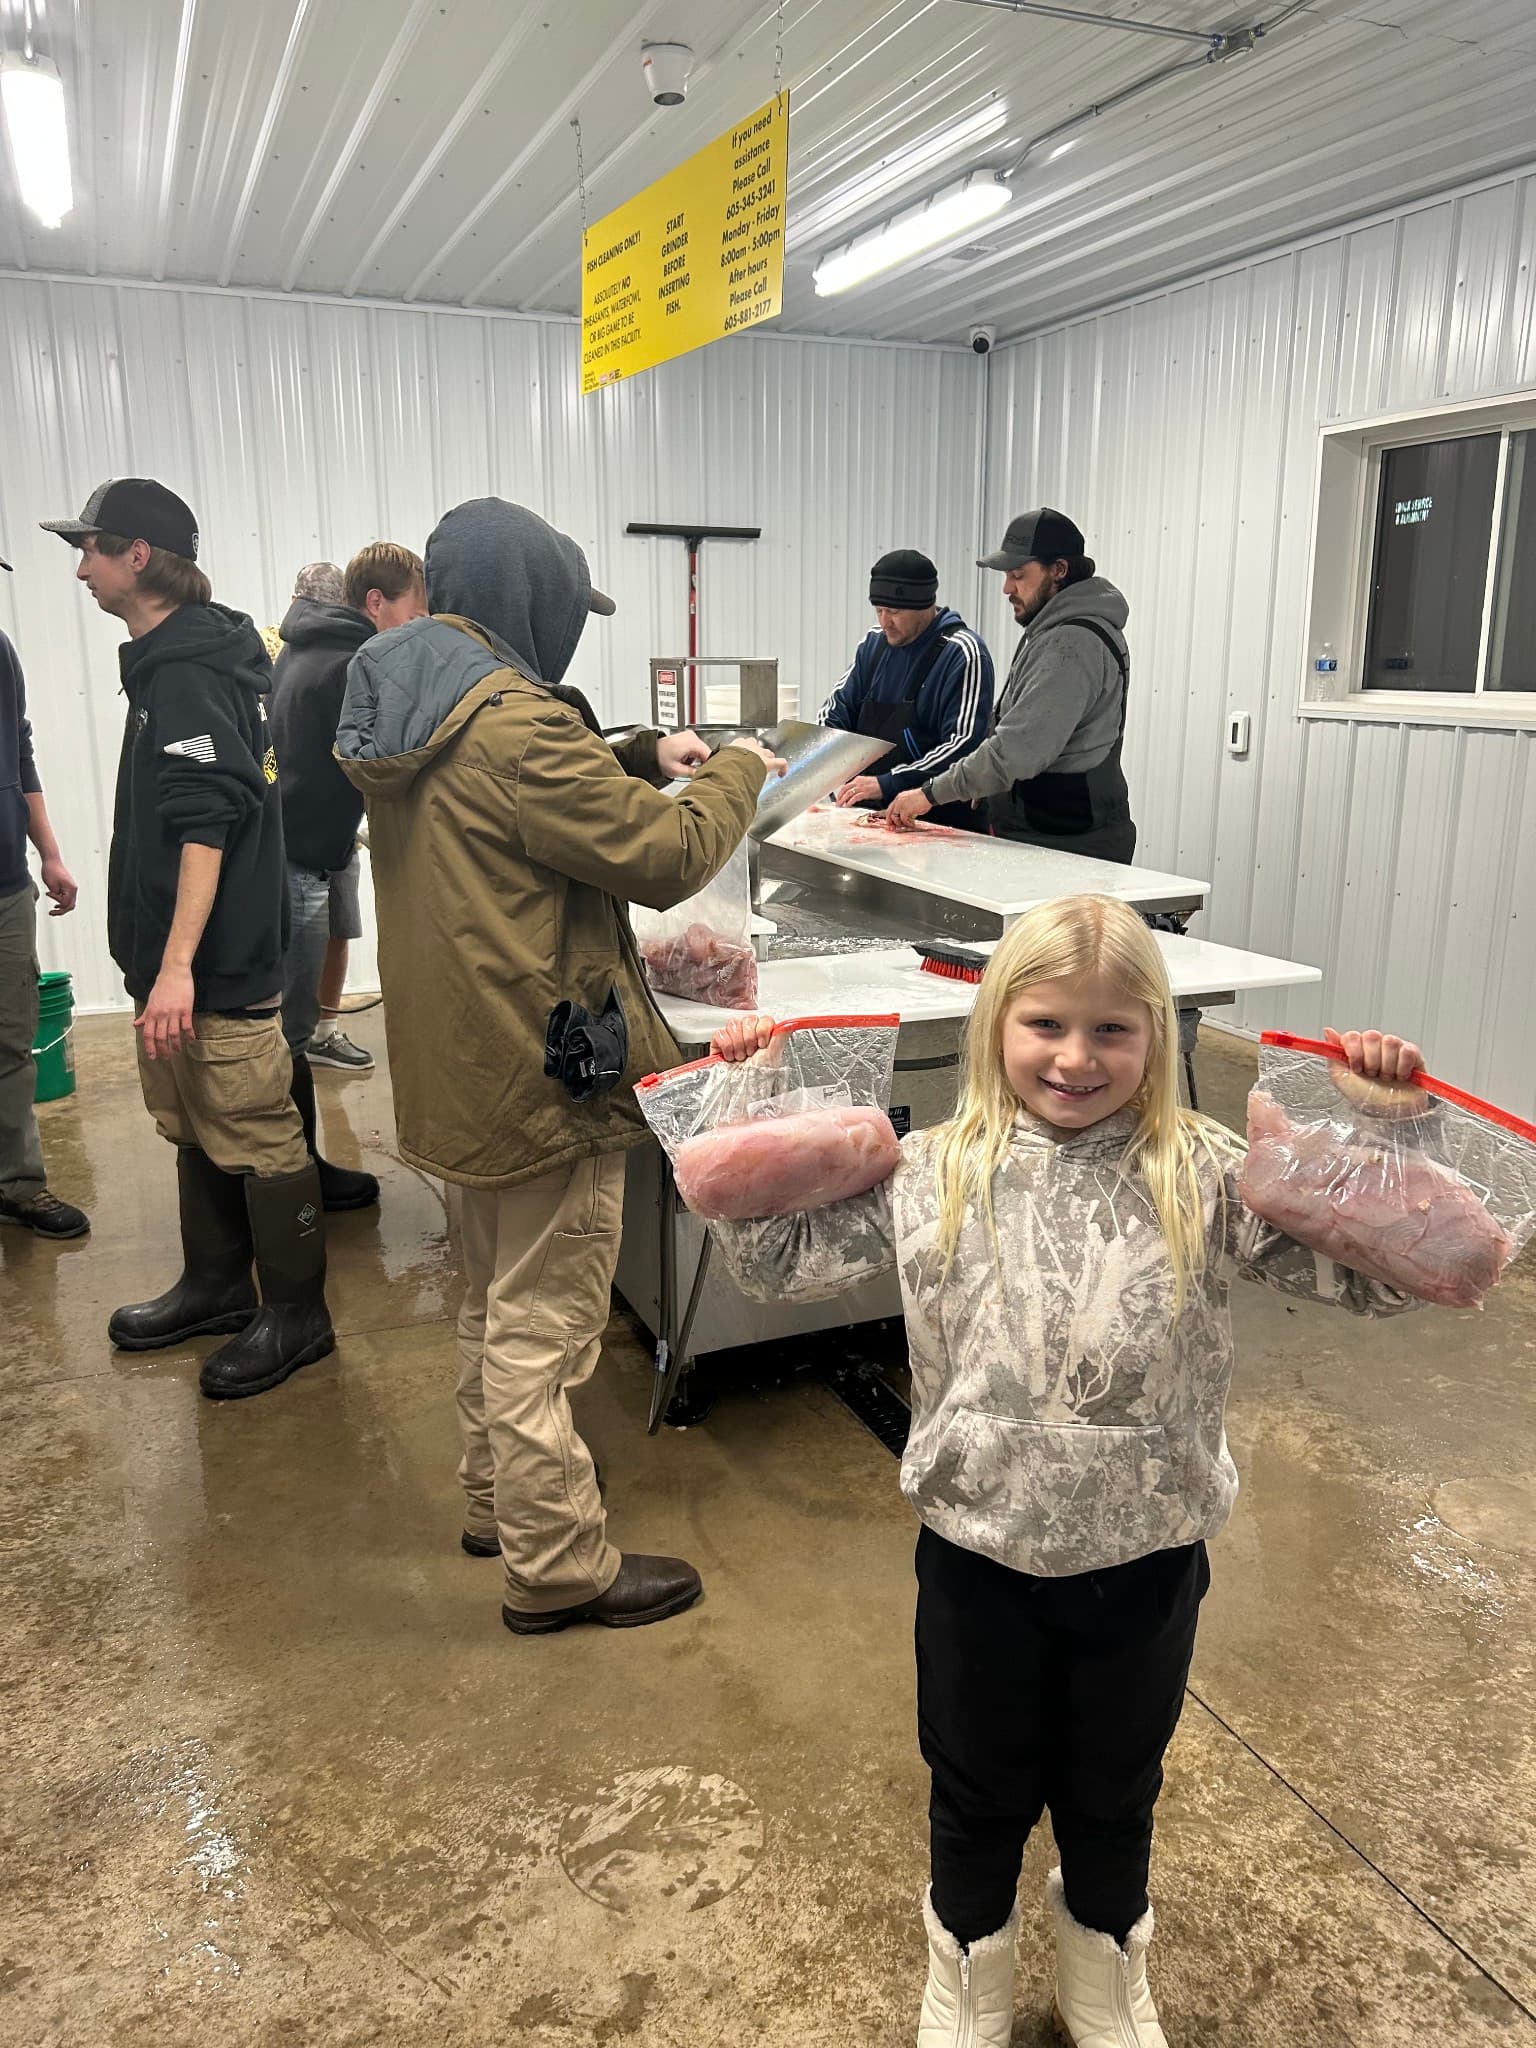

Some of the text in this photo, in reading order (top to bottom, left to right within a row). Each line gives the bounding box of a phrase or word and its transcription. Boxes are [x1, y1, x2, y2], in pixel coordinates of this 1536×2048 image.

[732, 108, 772, 149] If you need
[734, 138, 770, 170] assistance
[733, 157, 771, 194] Please Call
[726, 179, 776, 220] 605-345-3241
[666, 212, 684, 234] START
[722, 220, 750, 246] Monday
[756, 204, 780, 228] Friday
[586, 230, 641, 274] FISH CLEANING ONLY!
[662, 232, 688, 258] GRINDER
[720, 243, 746, 268] 8:00am
[752, 228, 780, 252] 5:00pm
[664, 254, 686, 277] BEFORE
[728, 257, 767, 286] After hours
[594, 276, 631, 305] ABSOLUTELY NO
[658, 272, 690, 300] INSERTING
[730, 275, 767, 308] Please Call
[666, 299, 681, 316] FISH.
[724, 298, 771, 331] 605-881-2177
[597, 327, 605, 340] BIG
[606, 319, 620, 335] GAME
[621, 316, 627, 328] TO
[628, 312, 634, 325] BE
[584, 346, 603, 364] CLEANED
[604, 342, 610, 355] IN
[610, 338, 620, 352] THIS
